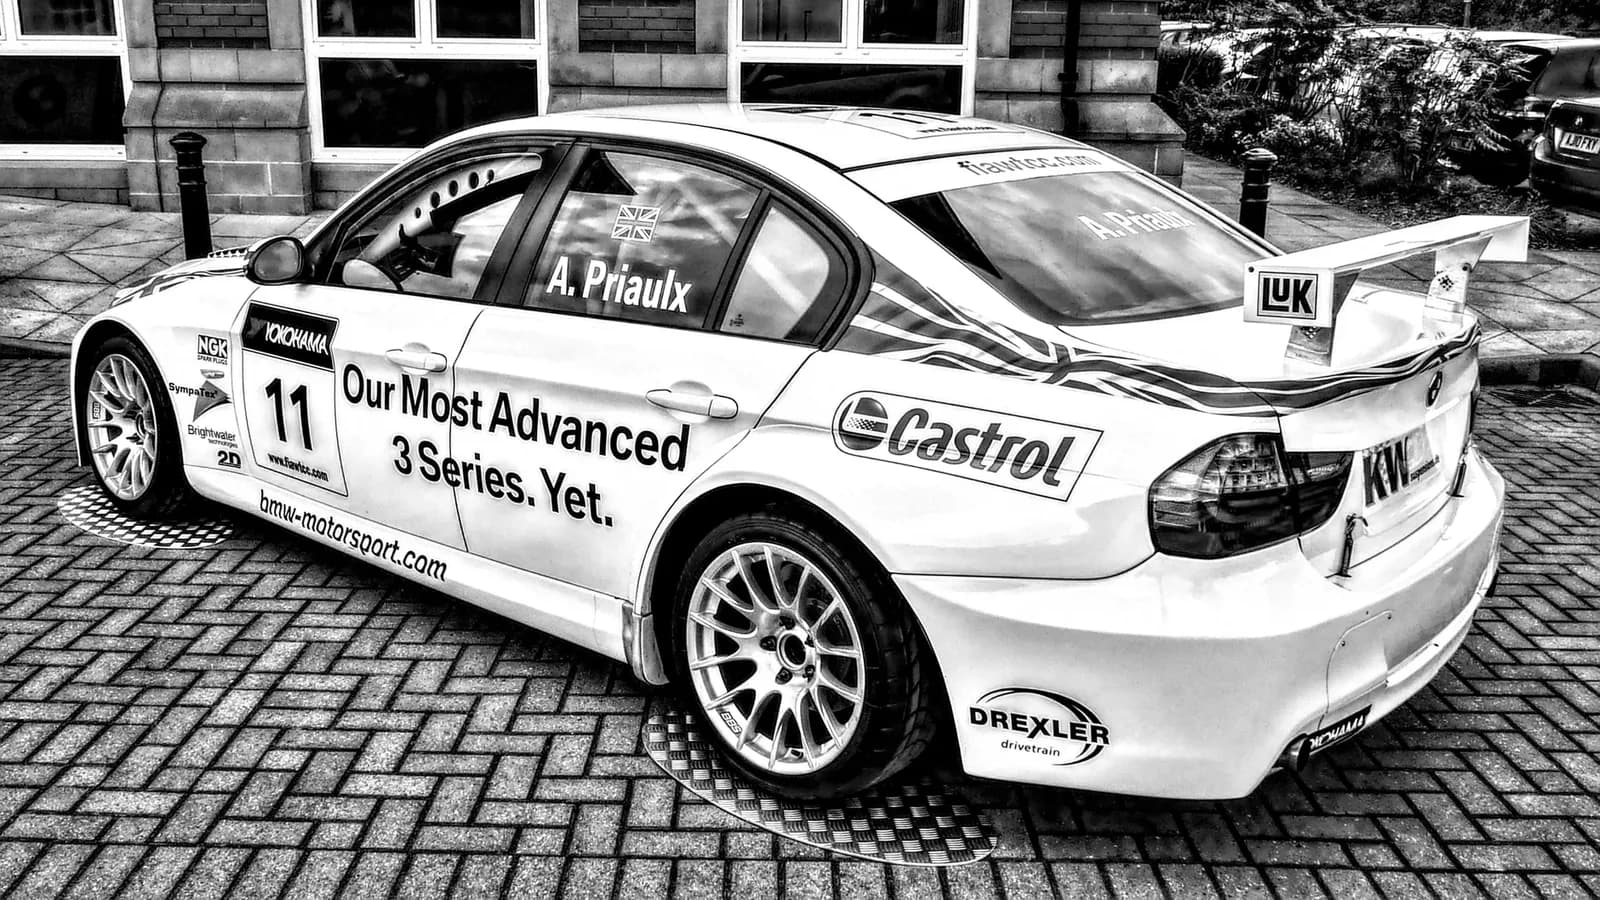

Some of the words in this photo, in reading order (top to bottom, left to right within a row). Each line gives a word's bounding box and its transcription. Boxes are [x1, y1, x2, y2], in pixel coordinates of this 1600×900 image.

[546, 256, 575, 297] A.
[582, 259, 692, 313] Priaulx
[198, 336, 227, 358] NGK
[265, 322, 329, 355] YOKOHAMA
[187, 424, 236, 442] Brightwater
[265, 378, 313, 451] 11
[343, 363, 396, 411] Our
[401, 374, 483, 430] Most
[489, 391, 691, 472] Advanced
[267, 453, 329, 482] www.fiawtcc.com
[887, 407, 1076, 487] Castrol
[392, 435, 414, 475] 3
[418, 441, 536, 507] Series.
[540, 467, 614, 527] Yet.
[1363, 436, 1409, 508] KW
[259, 489, 448, 582] bmw-motorsport.com
[721, 712, 744, 735] BBS
[969, 706, 1110, 745] DREXLER
[1000, 739, 1061, 757] drivetrain
